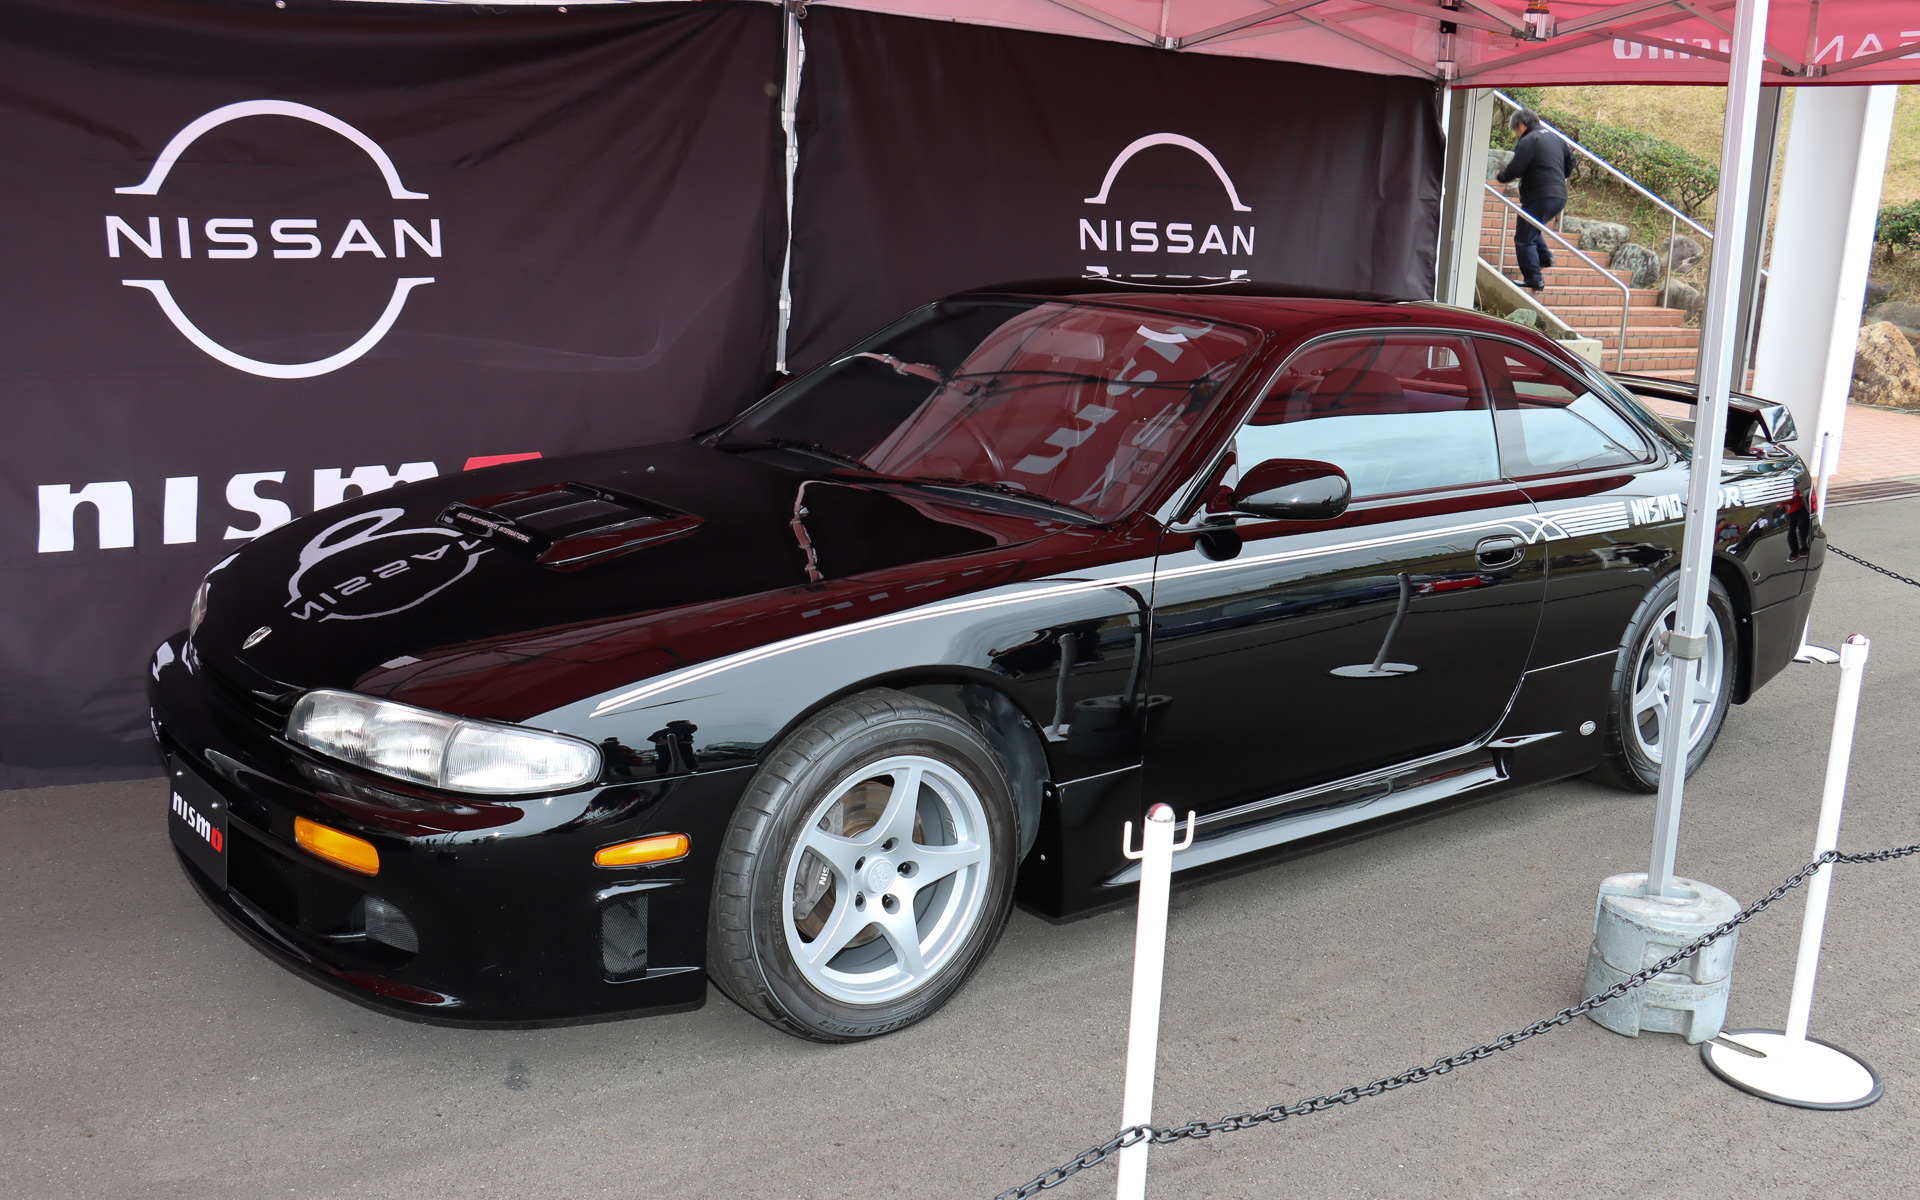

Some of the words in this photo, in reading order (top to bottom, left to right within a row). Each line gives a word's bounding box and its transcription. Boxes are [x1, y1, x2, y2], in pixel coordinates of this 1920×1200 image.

[105, 215, 442, 259] NISSAN
[1079, 218, 1255, 256] NISSAN
[37, 452, 543, 554] nism
[1629, 493, 1684, 526] NISMO
[172, 791, 223, 853] nismo
